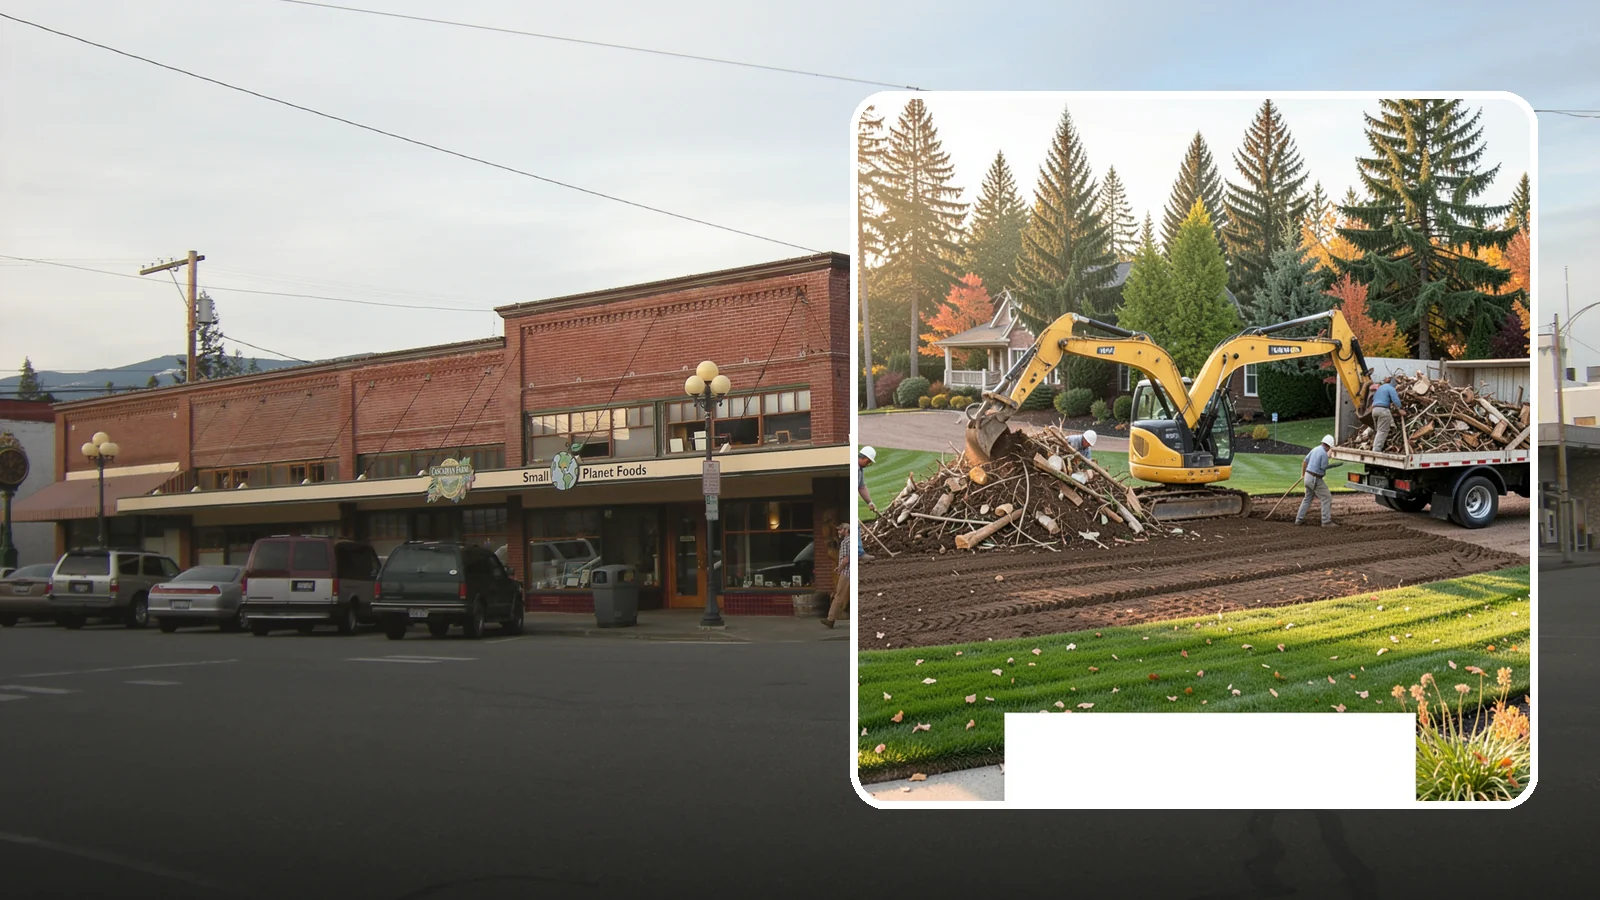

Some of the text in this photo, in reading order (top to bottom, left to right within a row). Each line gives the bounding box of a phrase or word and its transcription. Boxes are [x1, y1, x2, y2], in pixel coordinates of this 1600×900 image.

[523, 464, 647, 483] Small Planet Foods
